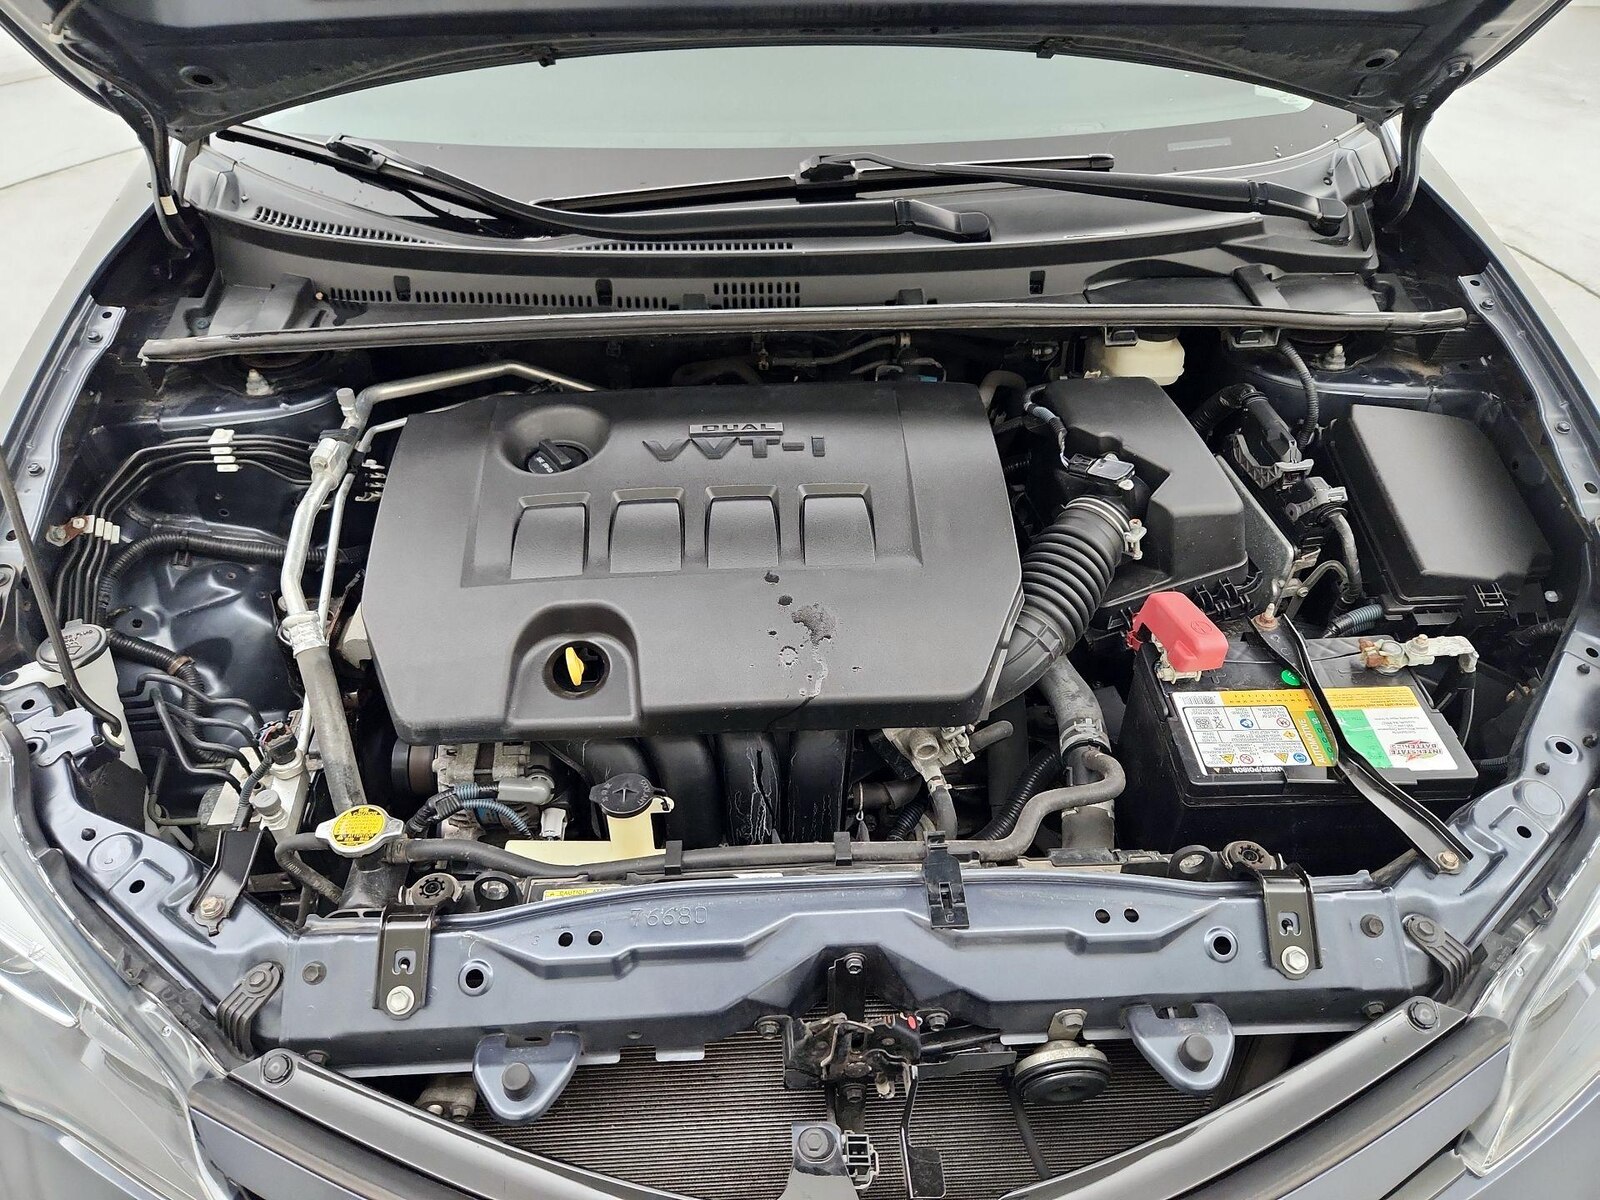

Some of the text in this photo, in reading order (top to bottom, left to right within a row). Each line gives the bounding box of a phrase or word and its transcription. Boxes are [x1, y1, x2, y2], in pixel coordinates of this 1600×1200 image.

[701, 423, 776, 432] DUAL
[1300, 718, 1327, 764] AUTOMOTIVE
[558, 889, 588, 897] CAUTION
